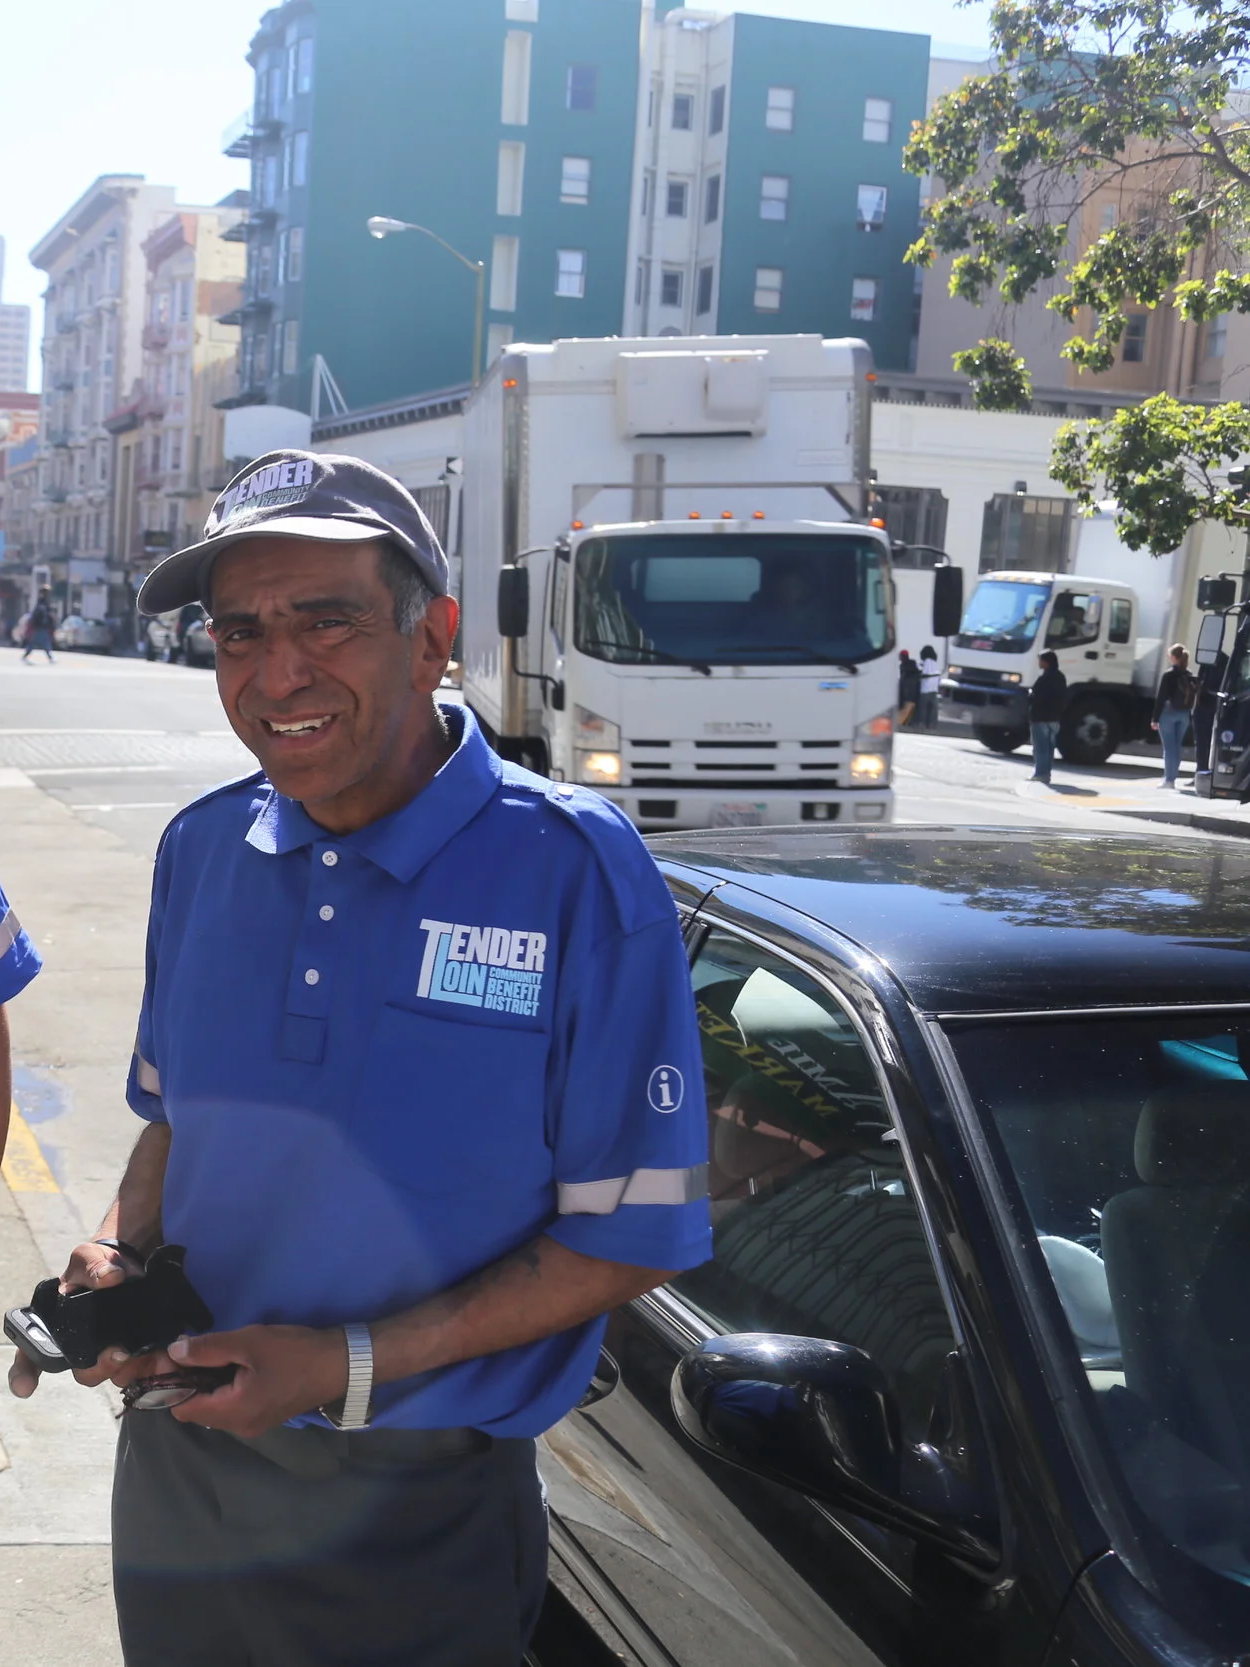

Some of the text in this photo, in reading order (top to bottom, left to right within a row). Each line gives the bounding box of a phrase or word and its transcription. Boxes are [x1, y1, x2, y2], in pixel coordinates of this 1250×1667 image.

[217, 460, 313, 523] TENDER
[261, 485, 310, 500] COMMUNITY
[416, 918, 548, 998] TENDER
[429, 933, 488, 1008] LOIN
[489, 966, 543, 985] COMMUNITY
[486, 977, 542, 1002] BENEFIT
[483, 993, 540, 1017] DISTRICT
